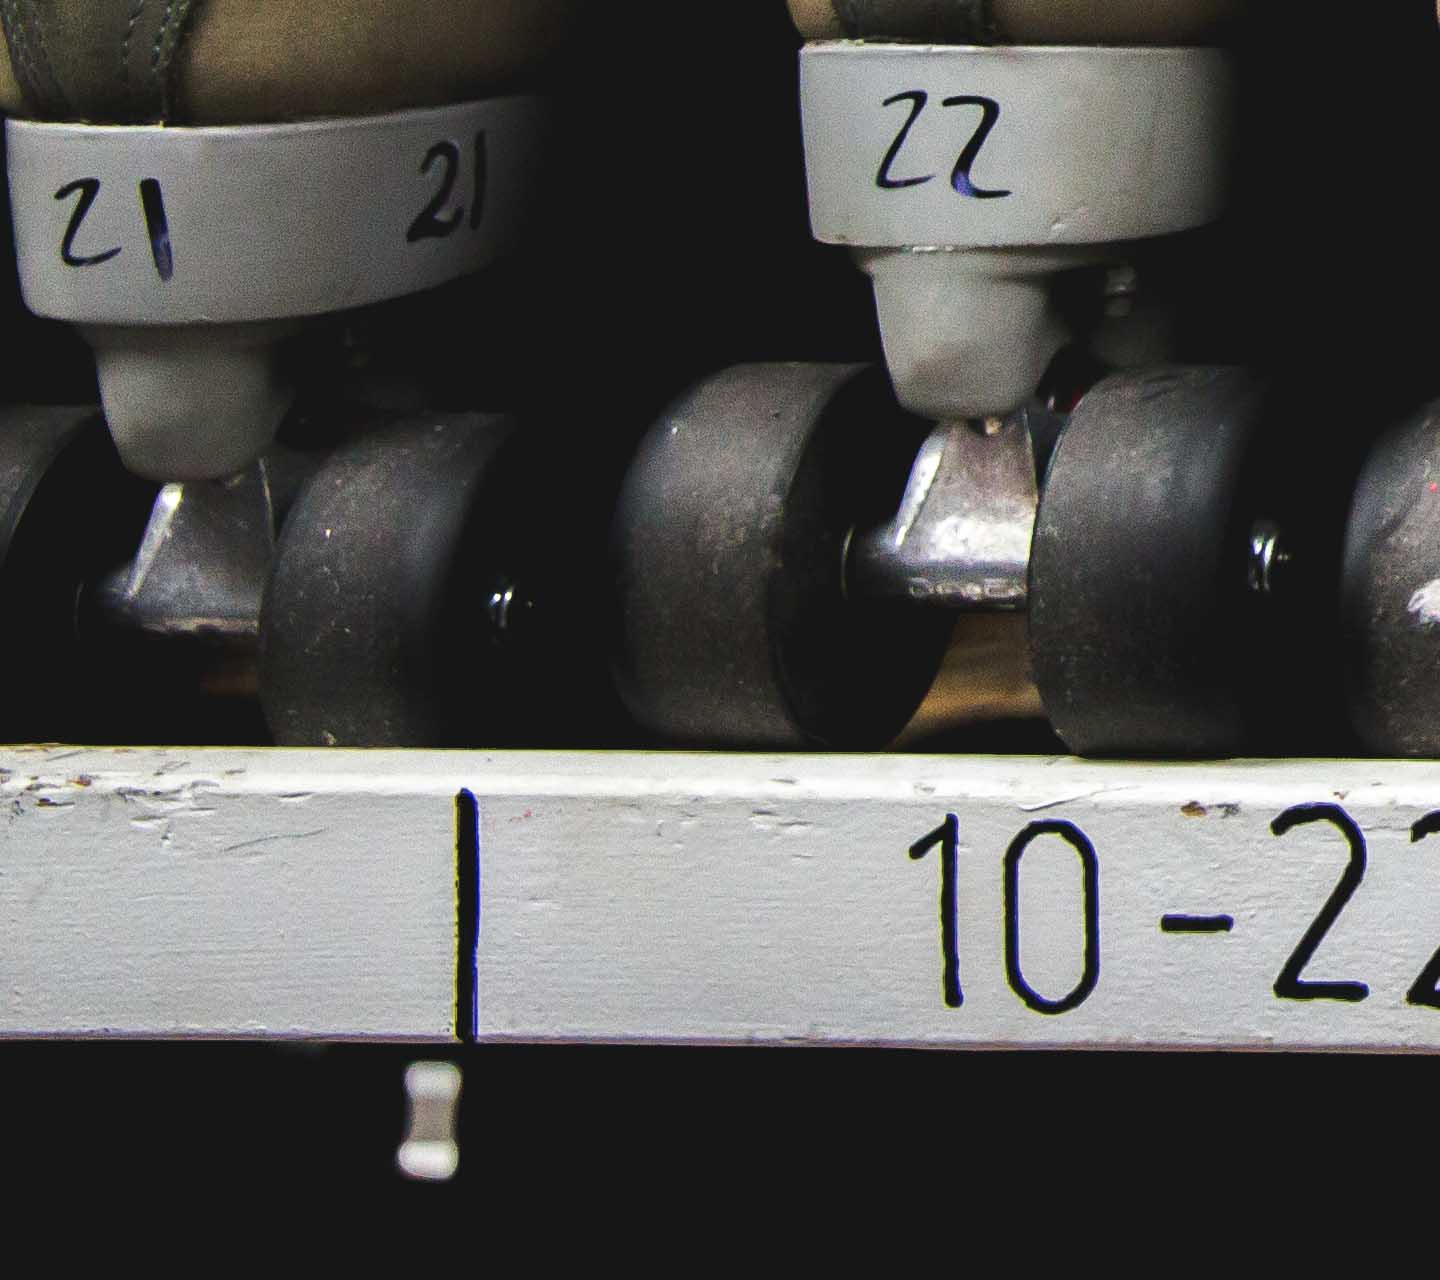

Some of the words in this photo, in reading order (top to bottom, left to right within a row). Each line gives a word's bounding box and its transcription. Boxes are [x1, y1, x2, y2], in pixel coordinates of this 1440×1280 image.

[406, 130, 489, 244] 21
[875, 90, 1011, 200] 22
[54, 177, 175, 282] 21
